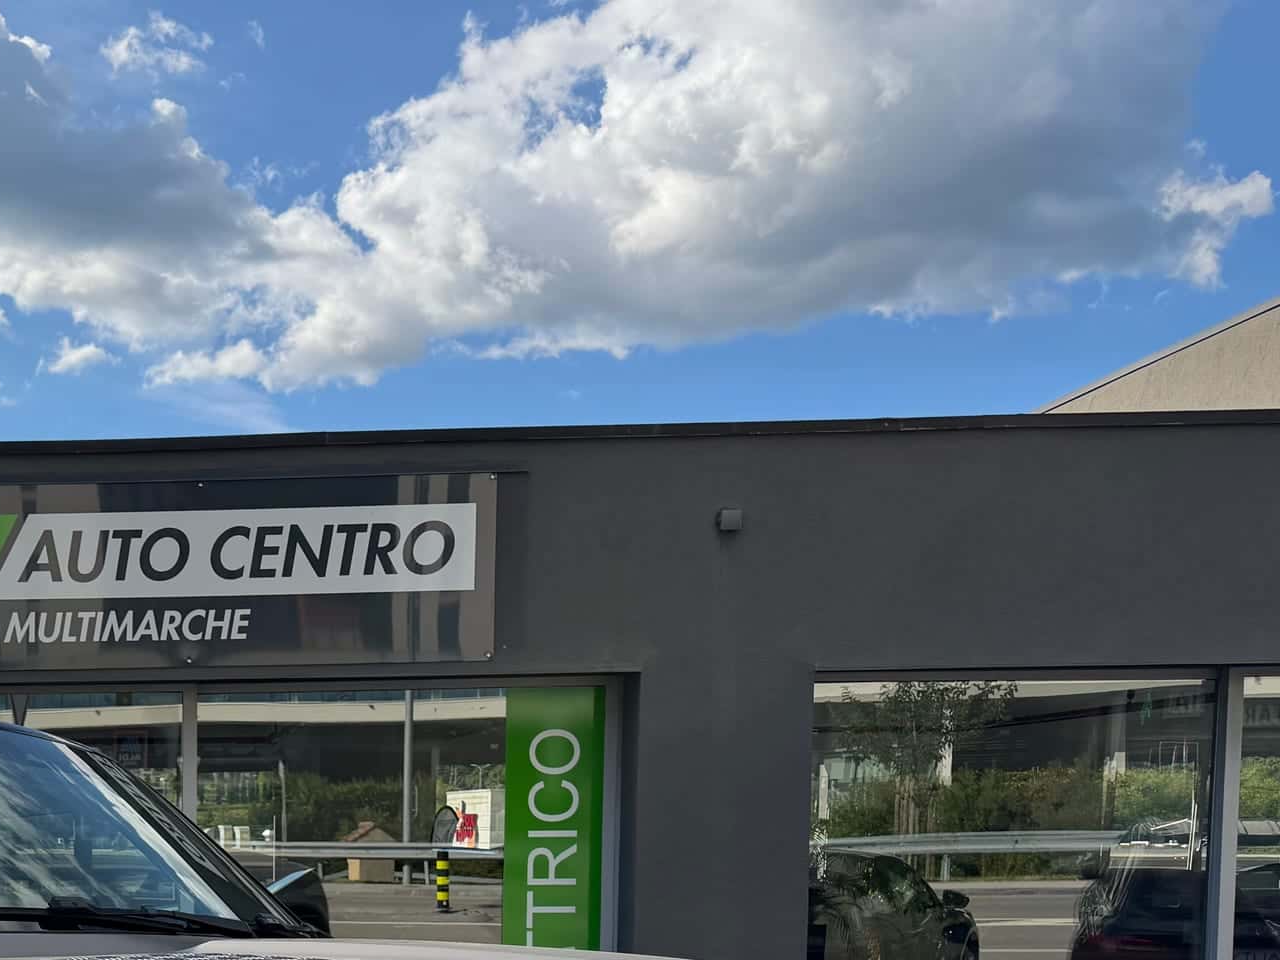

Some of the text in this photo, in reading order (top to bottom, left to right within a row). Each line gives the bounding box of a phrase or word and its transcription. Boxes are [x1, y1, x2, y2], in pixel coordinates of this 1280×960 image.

[18, 520, 456, 583] AUTO CENTRO
[3, 608, 252, 644] MULTIMARCHE
